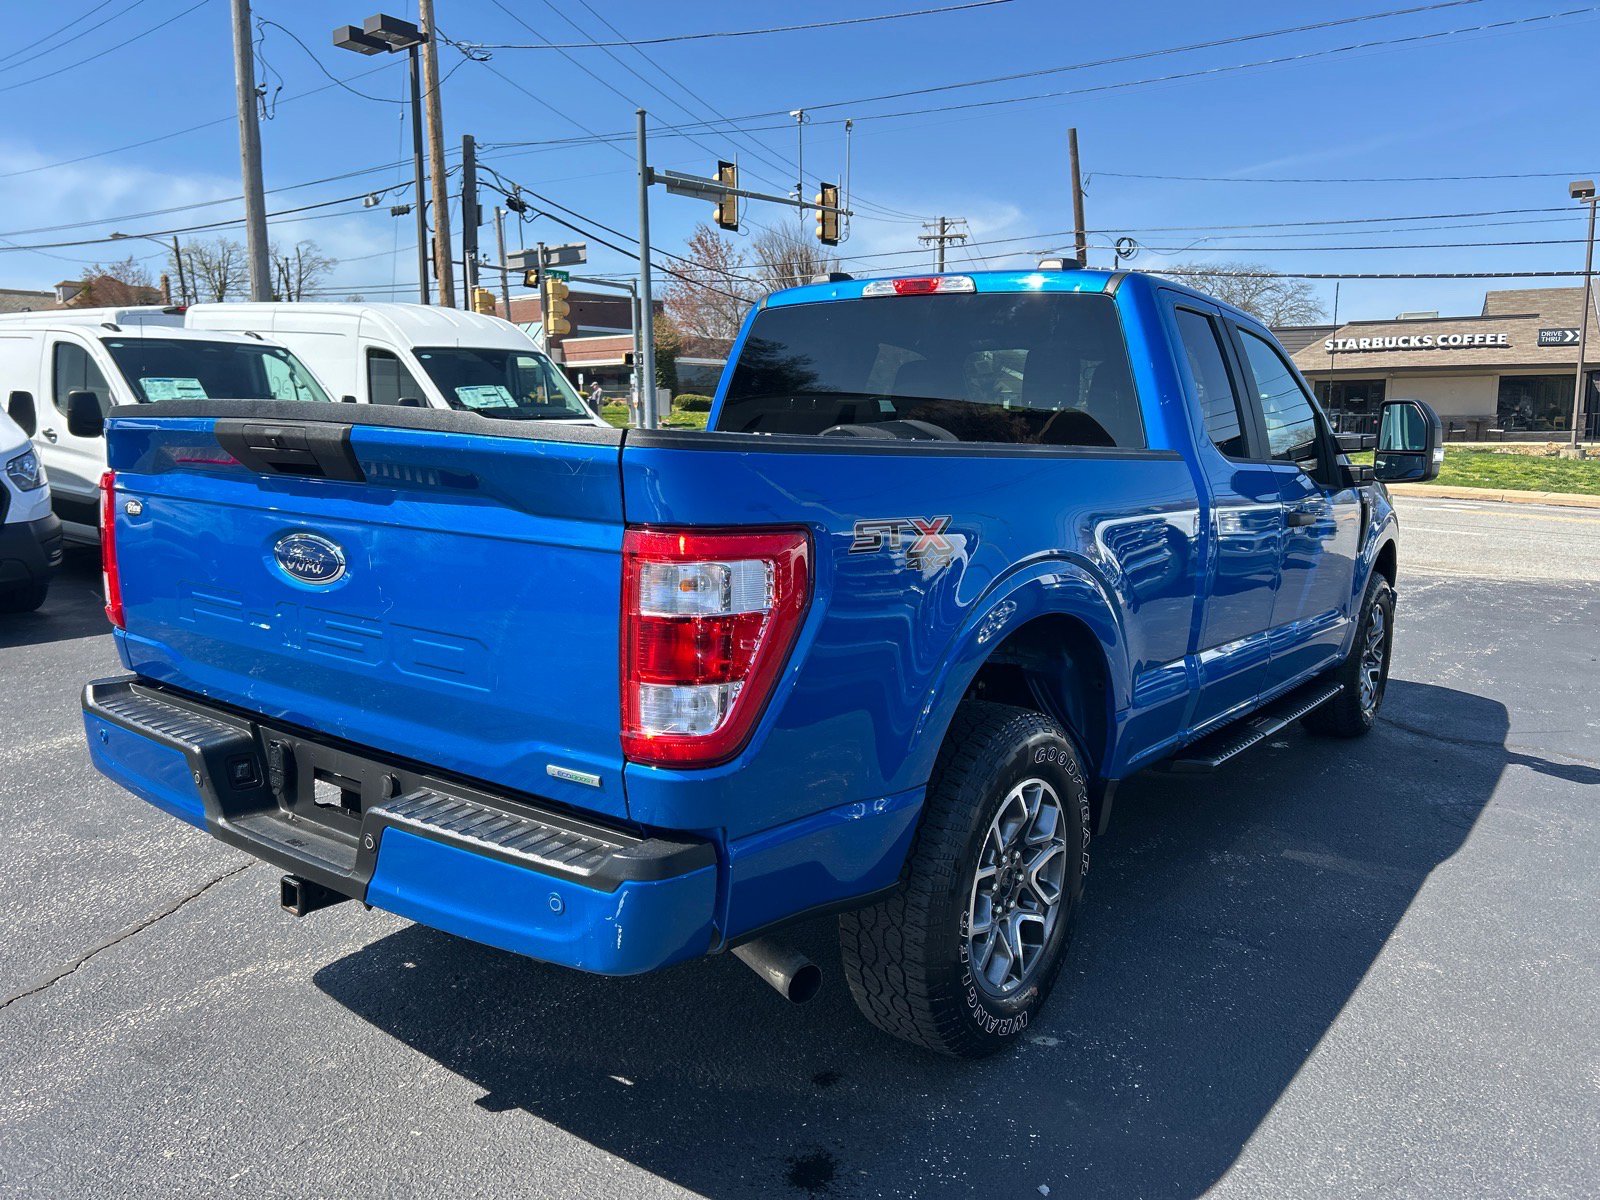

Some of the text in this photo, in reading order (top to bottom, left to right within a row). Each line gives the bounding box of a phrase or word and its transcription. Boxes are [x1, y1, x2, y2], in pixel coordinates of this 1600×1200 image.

[1324, 333, 1508, 350] STARBUCKS COFFEE
[848, 515, 954, 558] STX
[286, 544, 325, 574] Ford
[1034, 746, 1091, 876] GOODYEAR
[960, 910, 1028, 1036] WRANGLER
